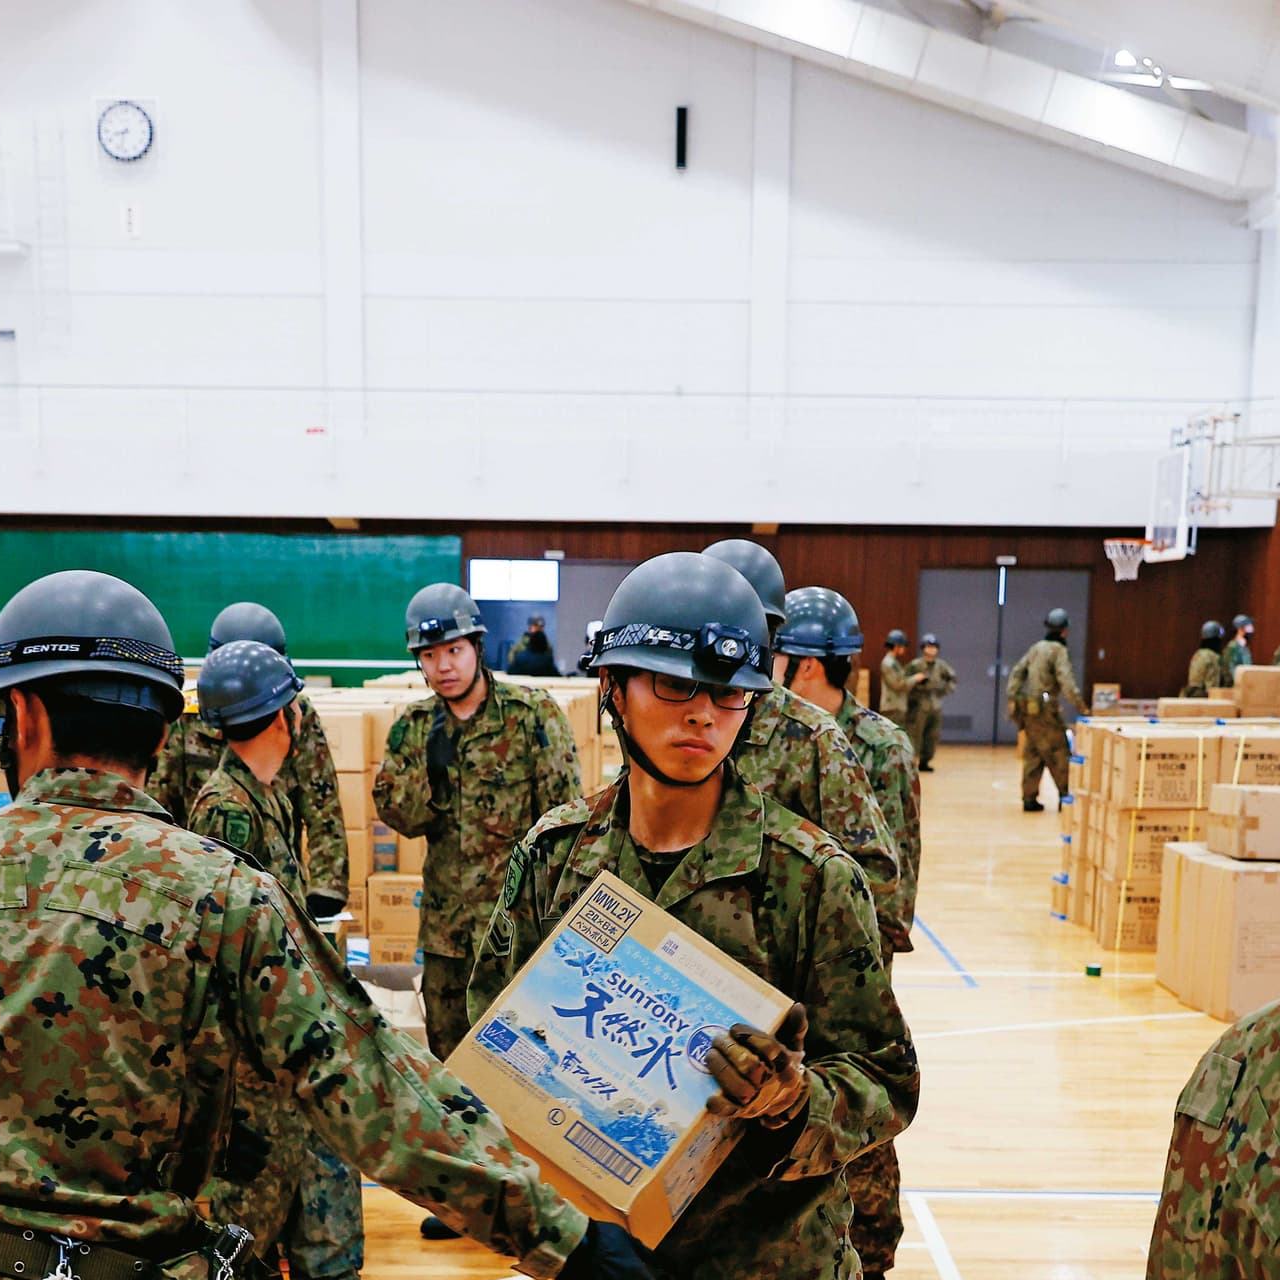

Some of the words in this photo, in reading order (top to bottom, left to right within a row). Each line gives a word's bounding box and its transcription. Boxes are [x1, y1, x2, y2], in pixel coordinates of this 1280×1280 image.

[22, 643, 81, 655] GENTOS
[592, 889, 637, 924] MWL2Y
[575, 920, 610, 947] ペットボトル
[606, 971, 690, 1034] SUNTORY
[551, 981, 684, 1091] 天然水
